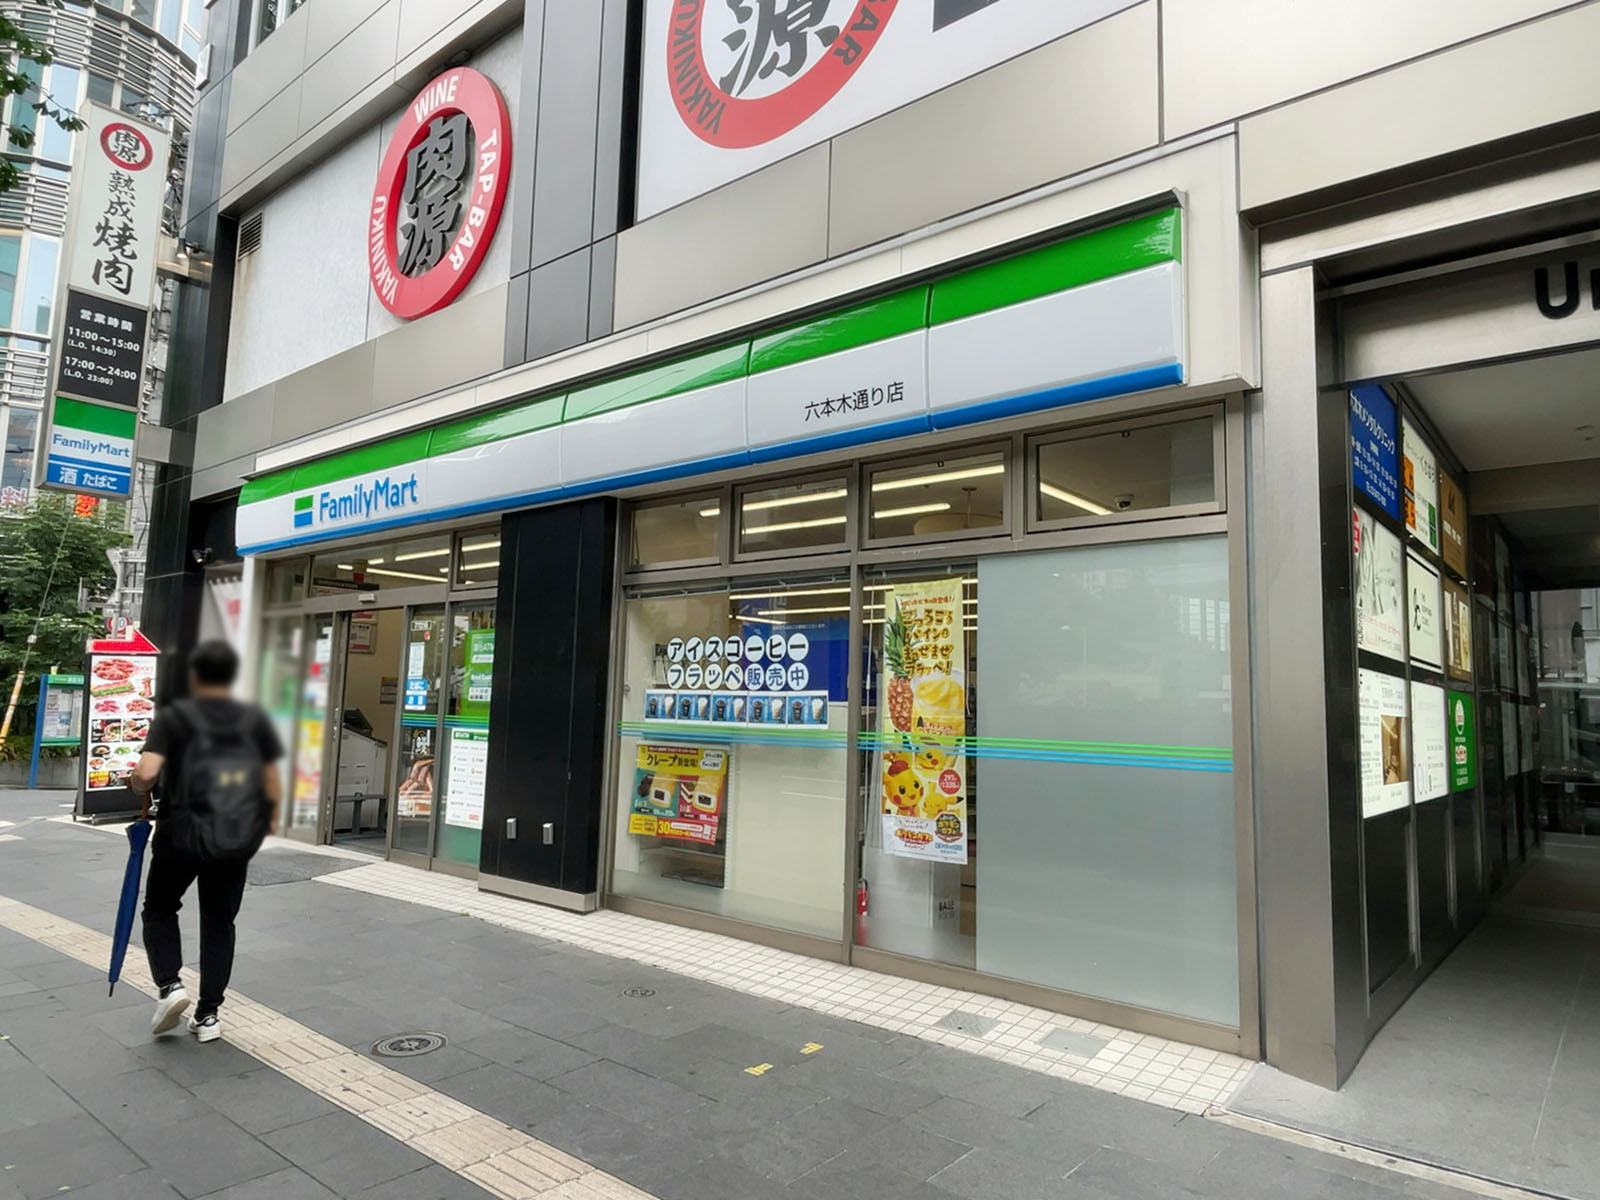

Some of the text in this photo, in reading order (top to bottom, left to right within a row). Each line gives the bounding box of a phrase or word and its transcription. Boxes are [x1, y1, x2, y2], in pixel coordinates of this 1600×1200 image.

[834, 0, 889, 67] AR
[414, 75, 460, 124] WINE
[397, 112, 466, 279] 肉源
[449, 127, 498, 272] TAP-BAR
[92, 170, 139, 296] 熟成焼肉
[370, 195, 399, 306] YAKINIKU
[1534, 260, 1600, 320] U
[79, 308, 134, 333] 営業時間
[804, 381, 904, 422] 六本木通り店
[53, 433, 131, 459] FamilyMart
[59, 466, 119, 491] 酒 たばこ
[319, 472, 418, 523] FamilyMart
[670, 638, 806, 661] アイスコーヒー
[669, 666, 806, 687] フラッペ販売中
